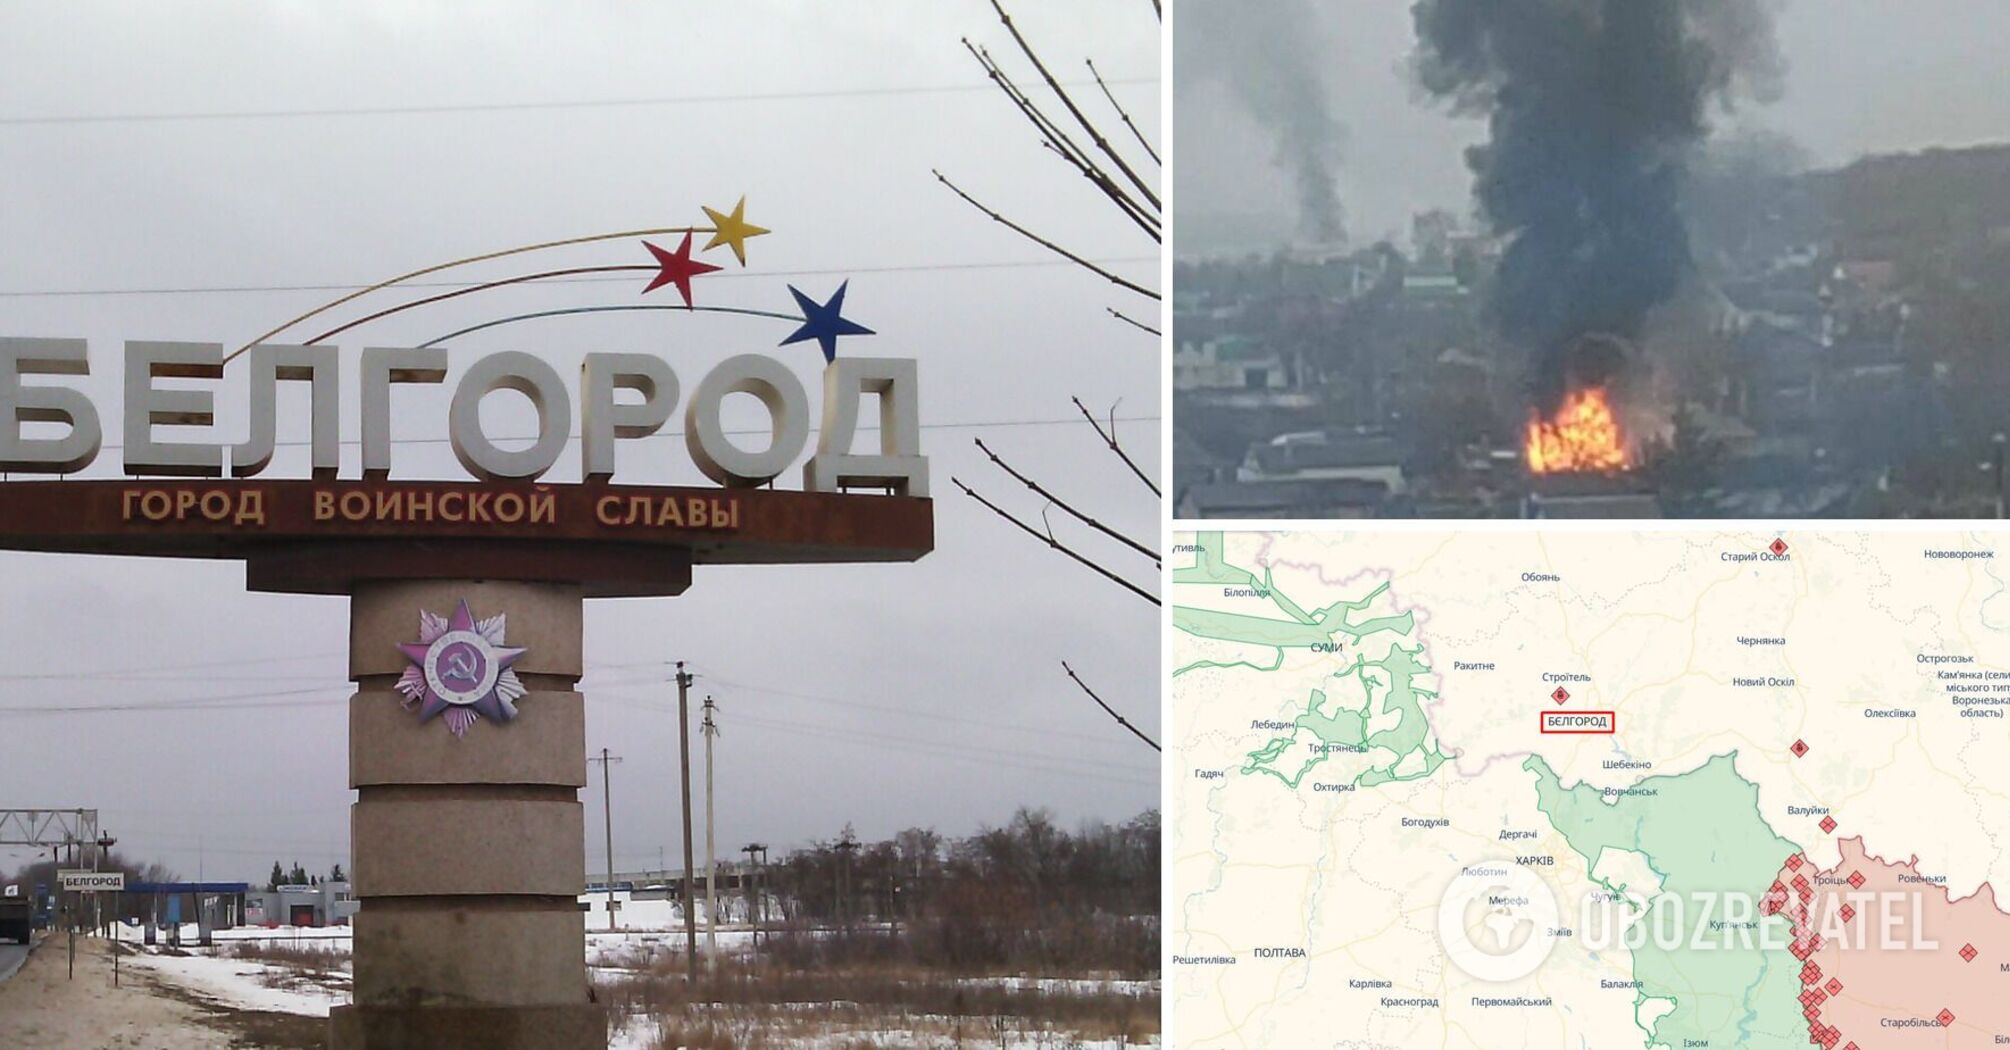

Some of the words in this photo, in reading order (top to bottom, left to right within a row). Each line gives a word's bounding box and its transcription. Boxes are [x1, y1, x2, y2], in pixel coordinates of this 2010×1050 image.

[0, 336, 930, 498] БЕЛГОРОД
[122, 489, 265, 525] ГОРОД
[314, 485, 556, 525] ВОИНСКОЙ
[597, 494, 741, 528] СЛАВЫ
[1721, 551, 1758, 563] Старий
[1924, 550, 1994, 560] Нововоронеж
[1521, 573, 1560, 582] Обоянь
[1311, 642, 1343, 653] СУМИ
[1737, 636, 1786, 648] Чернянка
[1917, 653, 1974, 665] Острогозьк
[1454, 660, 1495, 672] Ракитне
[1542, 672, 1591, 683] Строїтель
[1733, 676, 1765, 687] Новий
[1768, 677, 1795, 687] Оскіл
[1946, 683, 1990, 692] міського
[1864, 708, 1916, 719] Олексіївка
[1960, 708, 2004, 719] область)
[1251, 720, 1295, 731] Лебедин
[1548, 716, 1607, 728] БЄЛГОРОД
[1602, 760, 1651, 770] Шебекіно
[1195, 769, 1224, 779] Гадяч
[1313, 782, 1355, 794] Охтирка
[1604, 787, 1658, 797] Вовчанськ
[1788, 805, 1829, 817] Валуйки
[1401, 817, 1450, 828] Богодухів
[1499, 829, 1537, 841] Дергачі
[1516, 856, 1554, 866] ХАРКІВ
[1461, 867, 1508, 877] Люботин
[65, 877, 121, 887] БЕЛГОРОД
[1898, 874, 1947, 884] Ровеньки
[1488, 896, 1529, 906] Мерефа
[1254, 948, 1307, 958] ПОЛТАВА
[1172, 955, 1236, 965] Решетилівка
[1349, 979, 1392, 990] Карлівка
[1600, 979, 1644, 989] Балаклія
[1381, 997, 1439, 1008] Красноград
[1472, 997, 1552, 1008] Первомайський
[1880, 1017, 1945, 1029] Старобільсь
[1683, 1038, 1709, 1048] Ізюм
